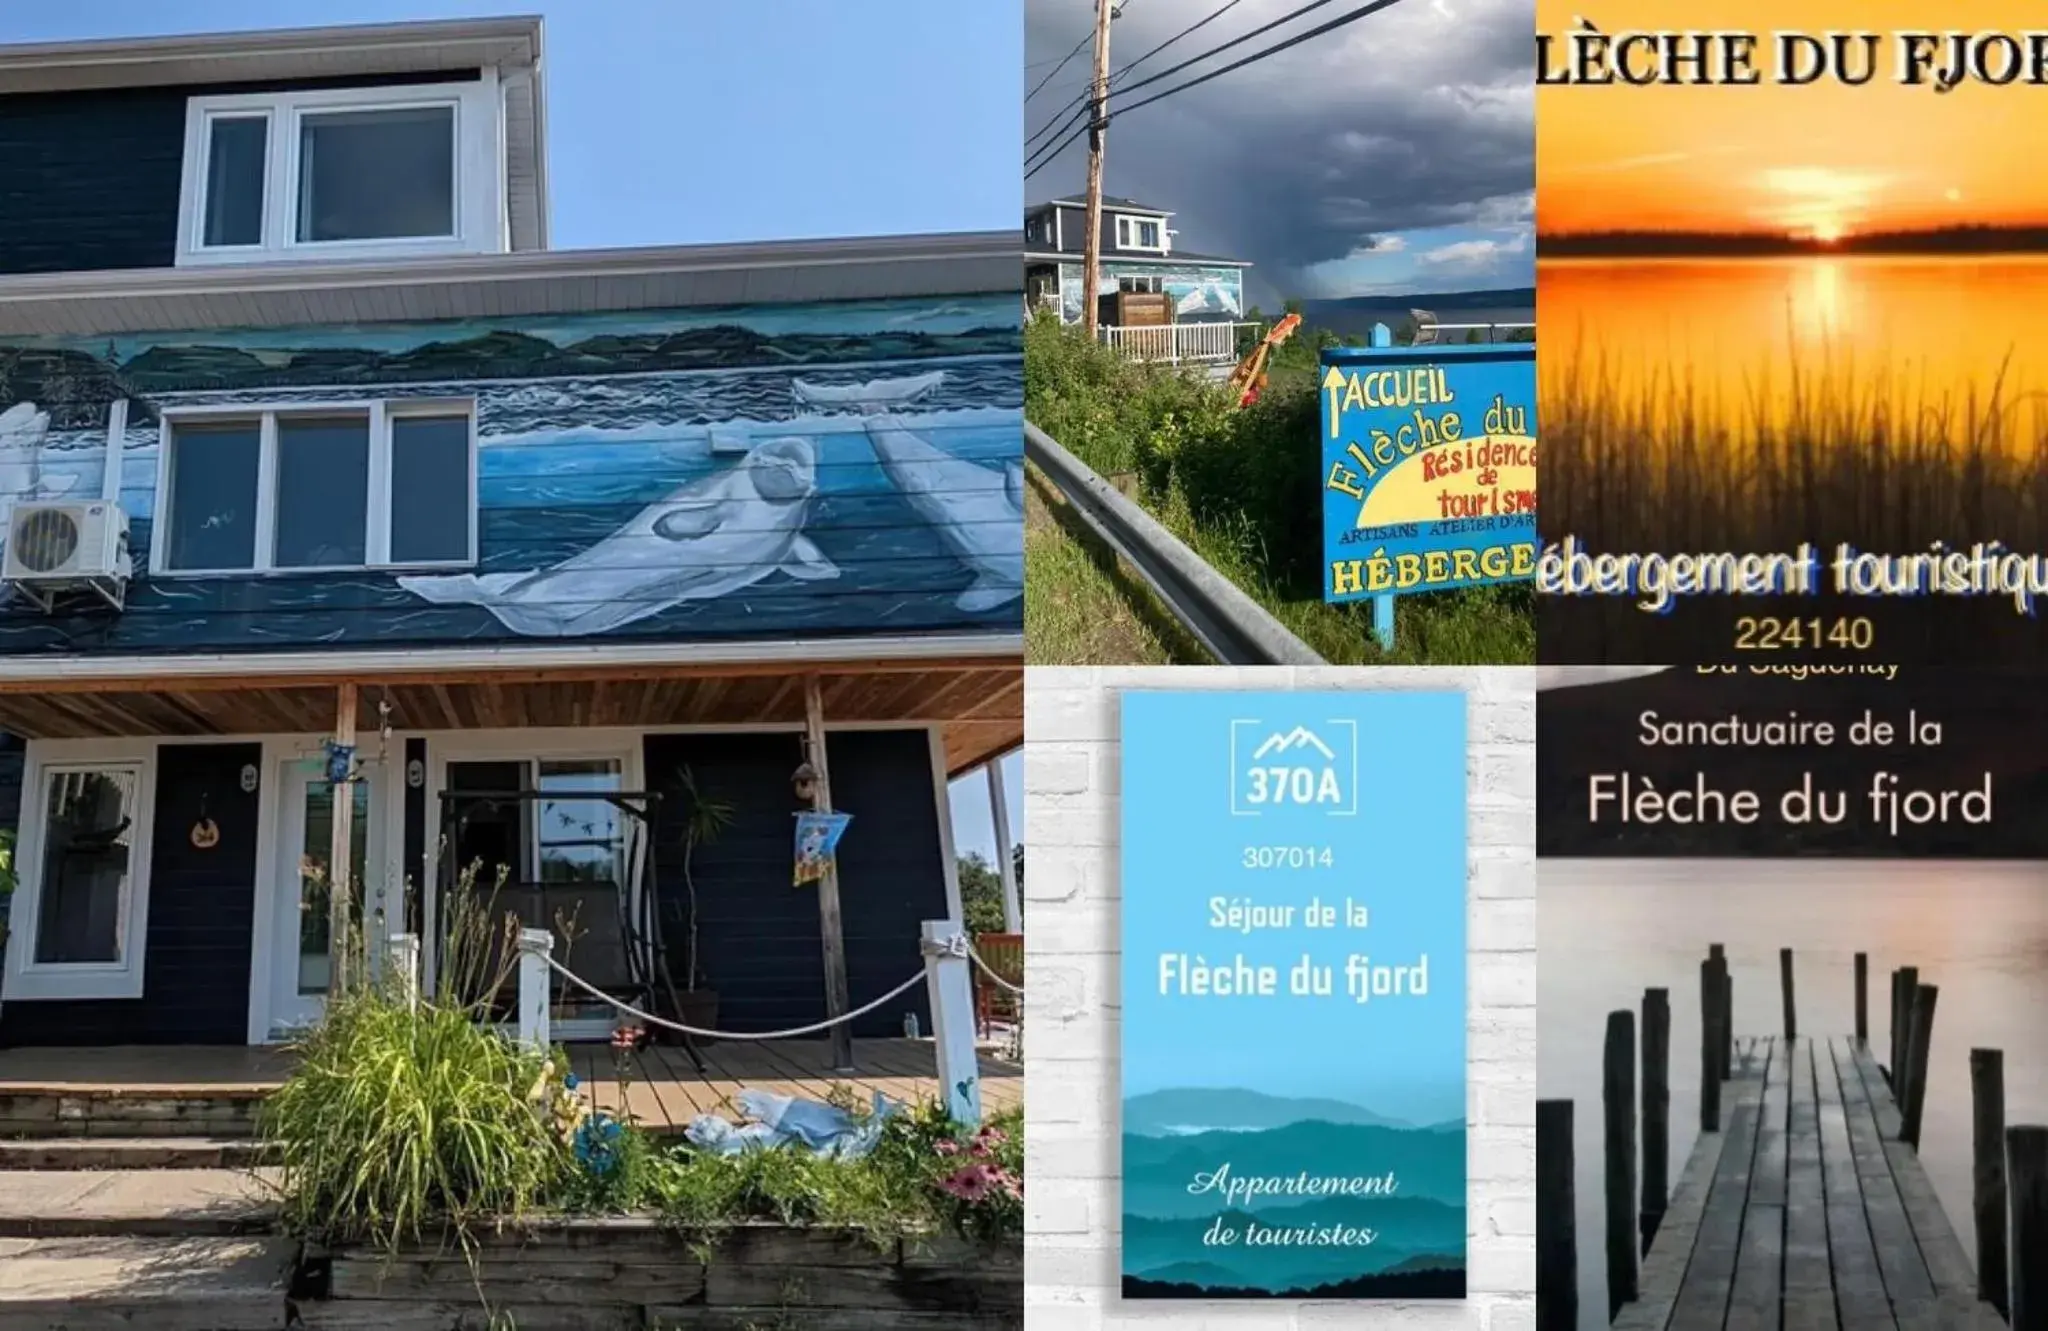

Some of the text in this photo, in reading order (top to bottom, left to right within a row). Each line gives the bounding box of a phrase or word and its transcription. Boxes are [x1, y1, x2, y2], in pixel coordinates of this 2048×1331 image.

[1775, 31, 1882, 86] DU
[1341, 364, 1454, 413] ACCUEIL
[1326, 394, 1527, 501] Flèche du
[1477, 467, 1498, 486] de
[1339, 523, 1418, 545] ARTISANS
[1429, 515, 1496, 537] ATELIER
[1331, 544, 1536, 595] HÉBERGE
[1734, 617, 1873, 650] 224140
[1638, 710, 1943, 746] Sanctuaire de la
[1246, 767, 1341, 804] 370A
[1588, 772, 1993, 836] Flèche du fjord
[1242, 846, 1334, 868] 307014
[1209, 896, 1368, 934] Séjour de la
[1158, 953, 1429, 1004] Flèche du fjord
[1186, 1161, 1399, 1206] Appartement
[1202, 1216, 1378, 1246] de touristes
